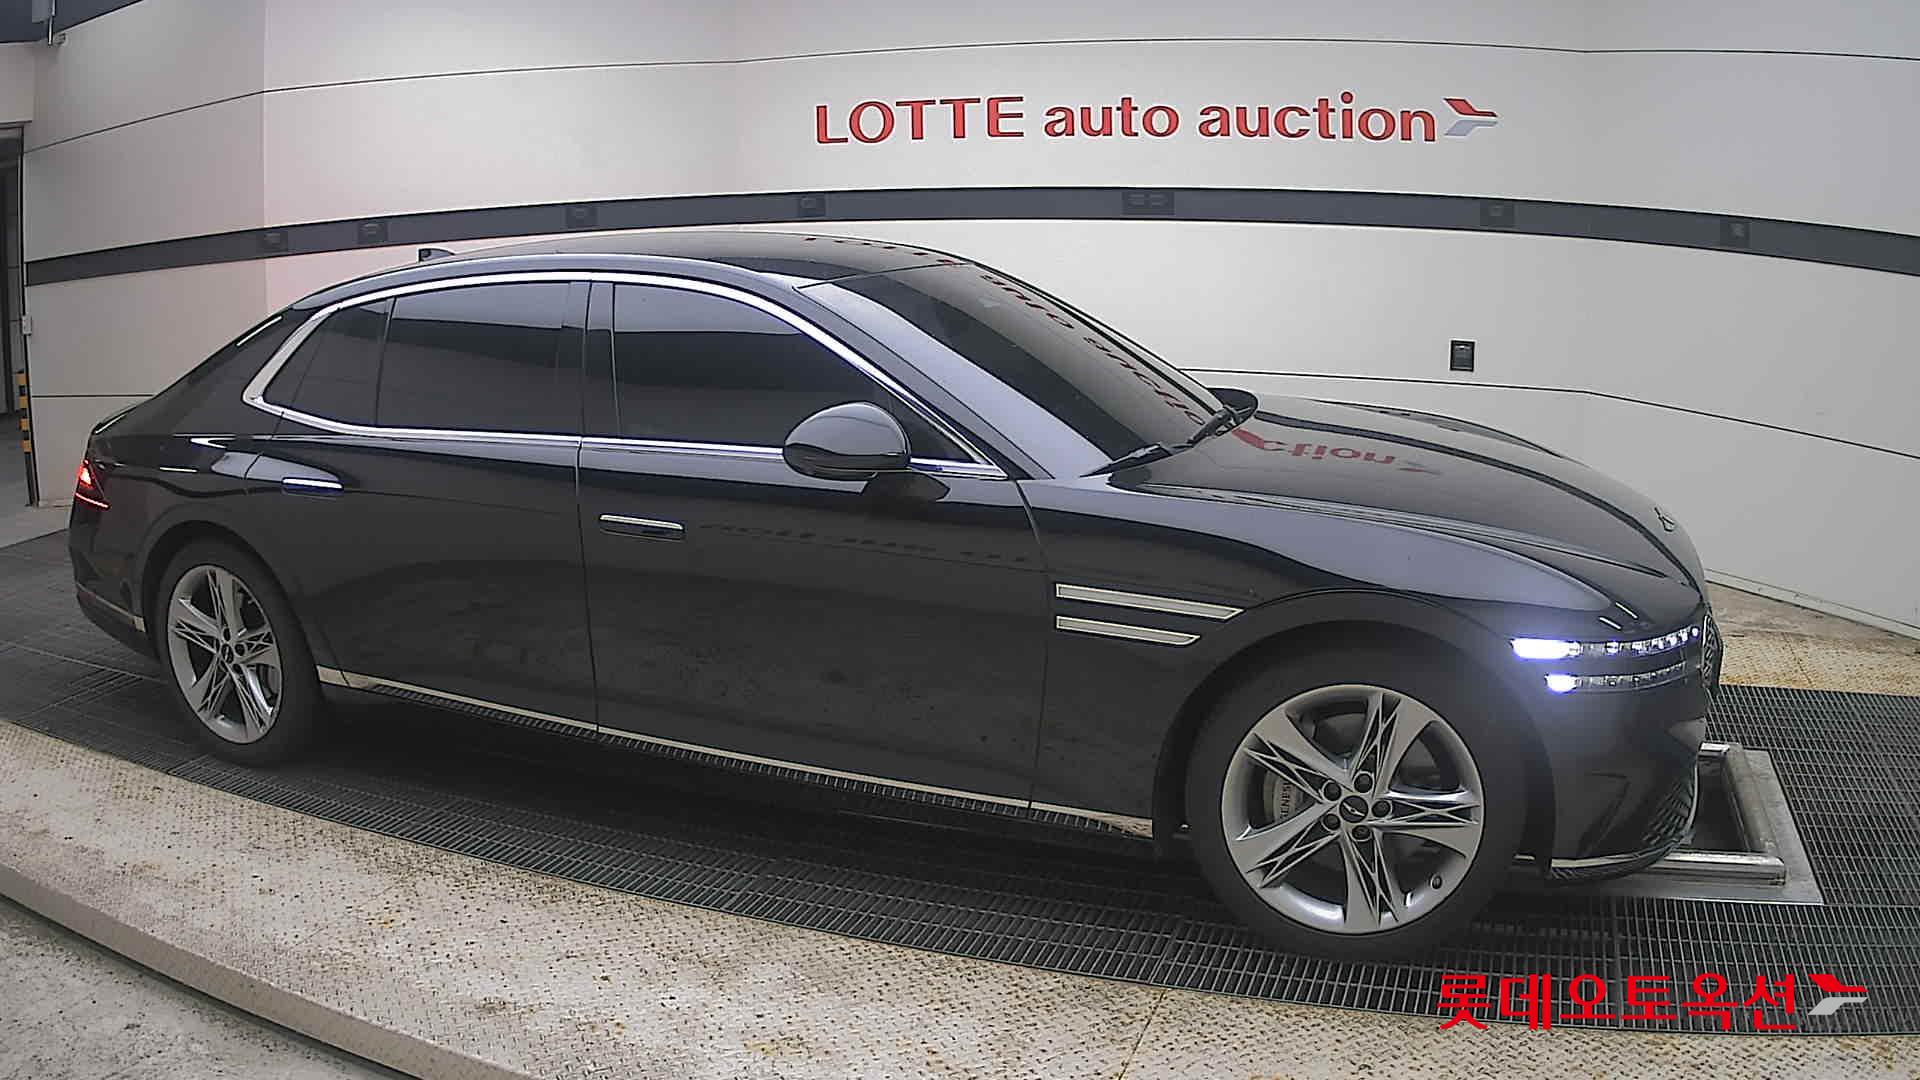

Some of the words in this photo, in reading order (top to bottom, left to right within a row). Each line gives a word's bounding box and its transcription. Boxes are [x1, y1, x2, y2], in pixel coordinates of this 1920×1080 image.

[816, 97, 1024, 144] LOTTE
[1044, 97, 1181, 138] auto
[1198, 91, 1438, 142] auction
